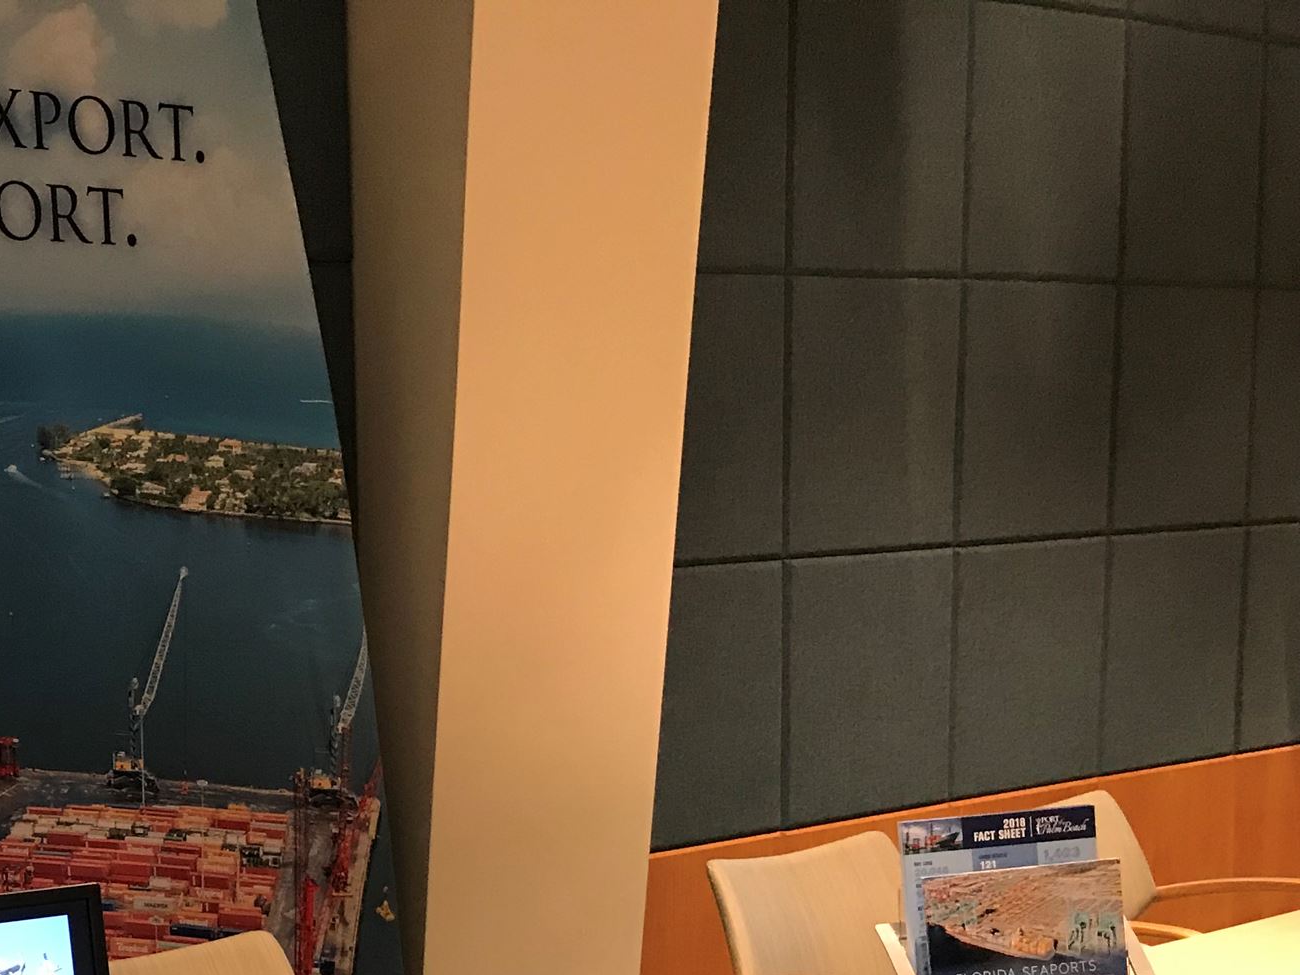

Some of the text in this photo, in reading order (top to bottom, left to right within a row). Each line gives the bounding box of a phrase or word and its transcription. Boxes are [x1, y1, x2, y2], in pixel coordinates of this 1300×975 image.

[1002, 817, 1026, 829] 2018
[973, 827, 1026, 842] FACT SHEET
